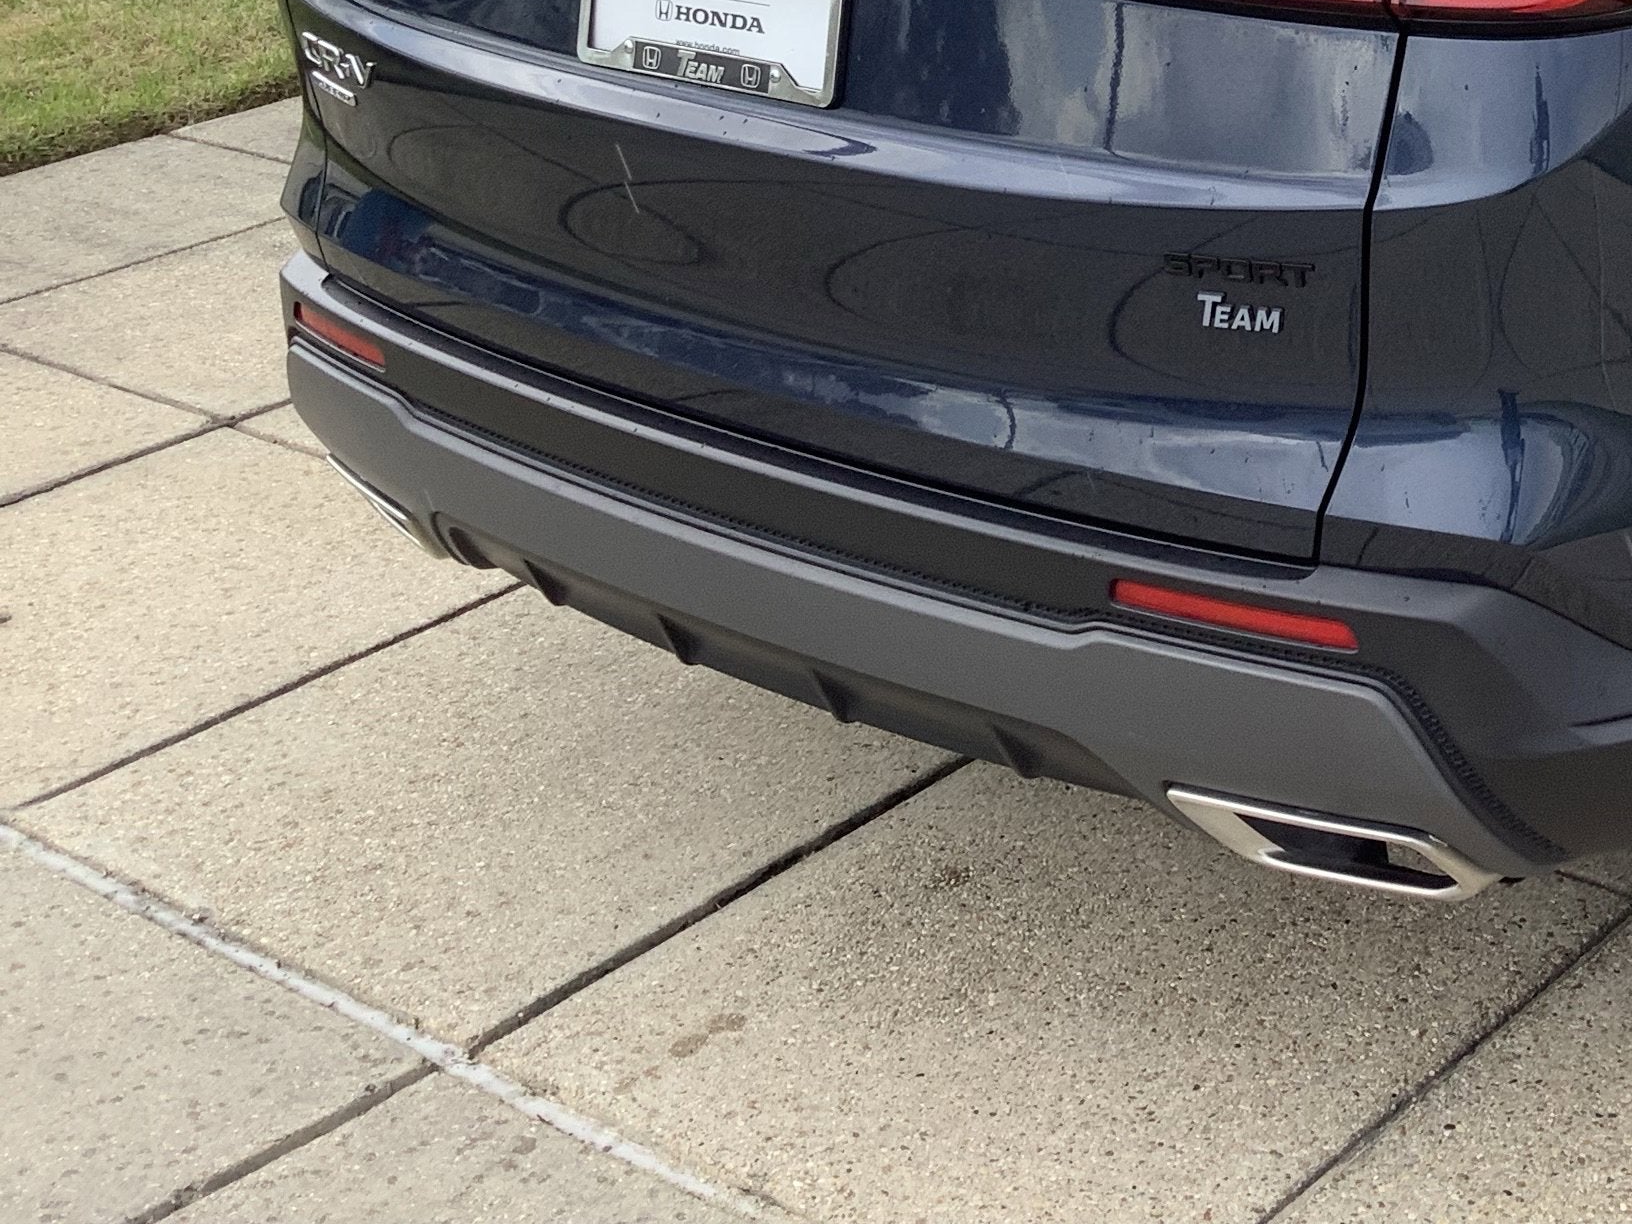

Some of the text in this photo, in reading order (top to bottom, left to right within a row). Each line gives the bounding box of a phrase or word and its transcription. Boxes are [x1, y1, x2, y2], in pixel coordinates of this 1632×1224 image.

[674, 5, 765, 35] HONDA
[302, 31, 377, 89] CR-V
[676, 39, 740, 56] www.honda.com
[1163, 251, 1316, 288] SPORT
